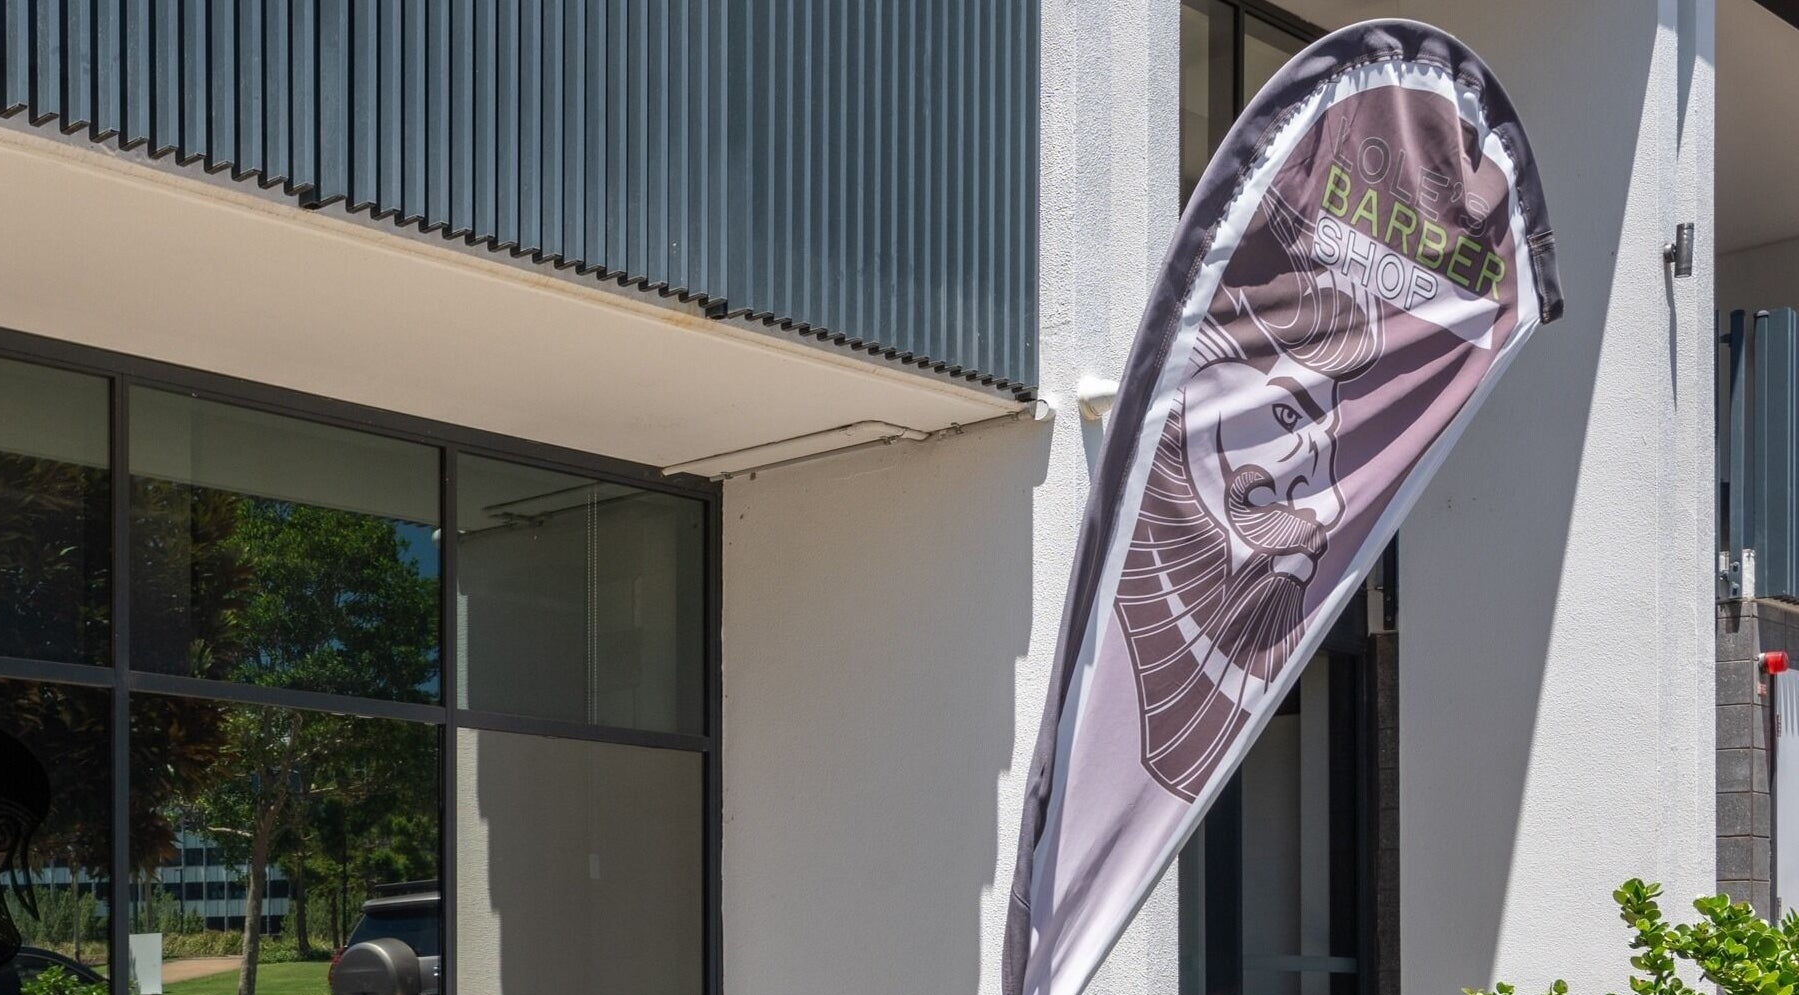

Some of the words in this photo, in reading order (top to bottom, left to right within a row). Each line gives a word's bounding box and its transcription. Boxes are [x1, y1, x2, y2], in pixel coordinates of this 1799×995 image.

[1320, 163, 1507, 301] BARBER
[1333, 115, 1491, 238] LOLE'S
[1313, 214, 1439, 311] SHOP
